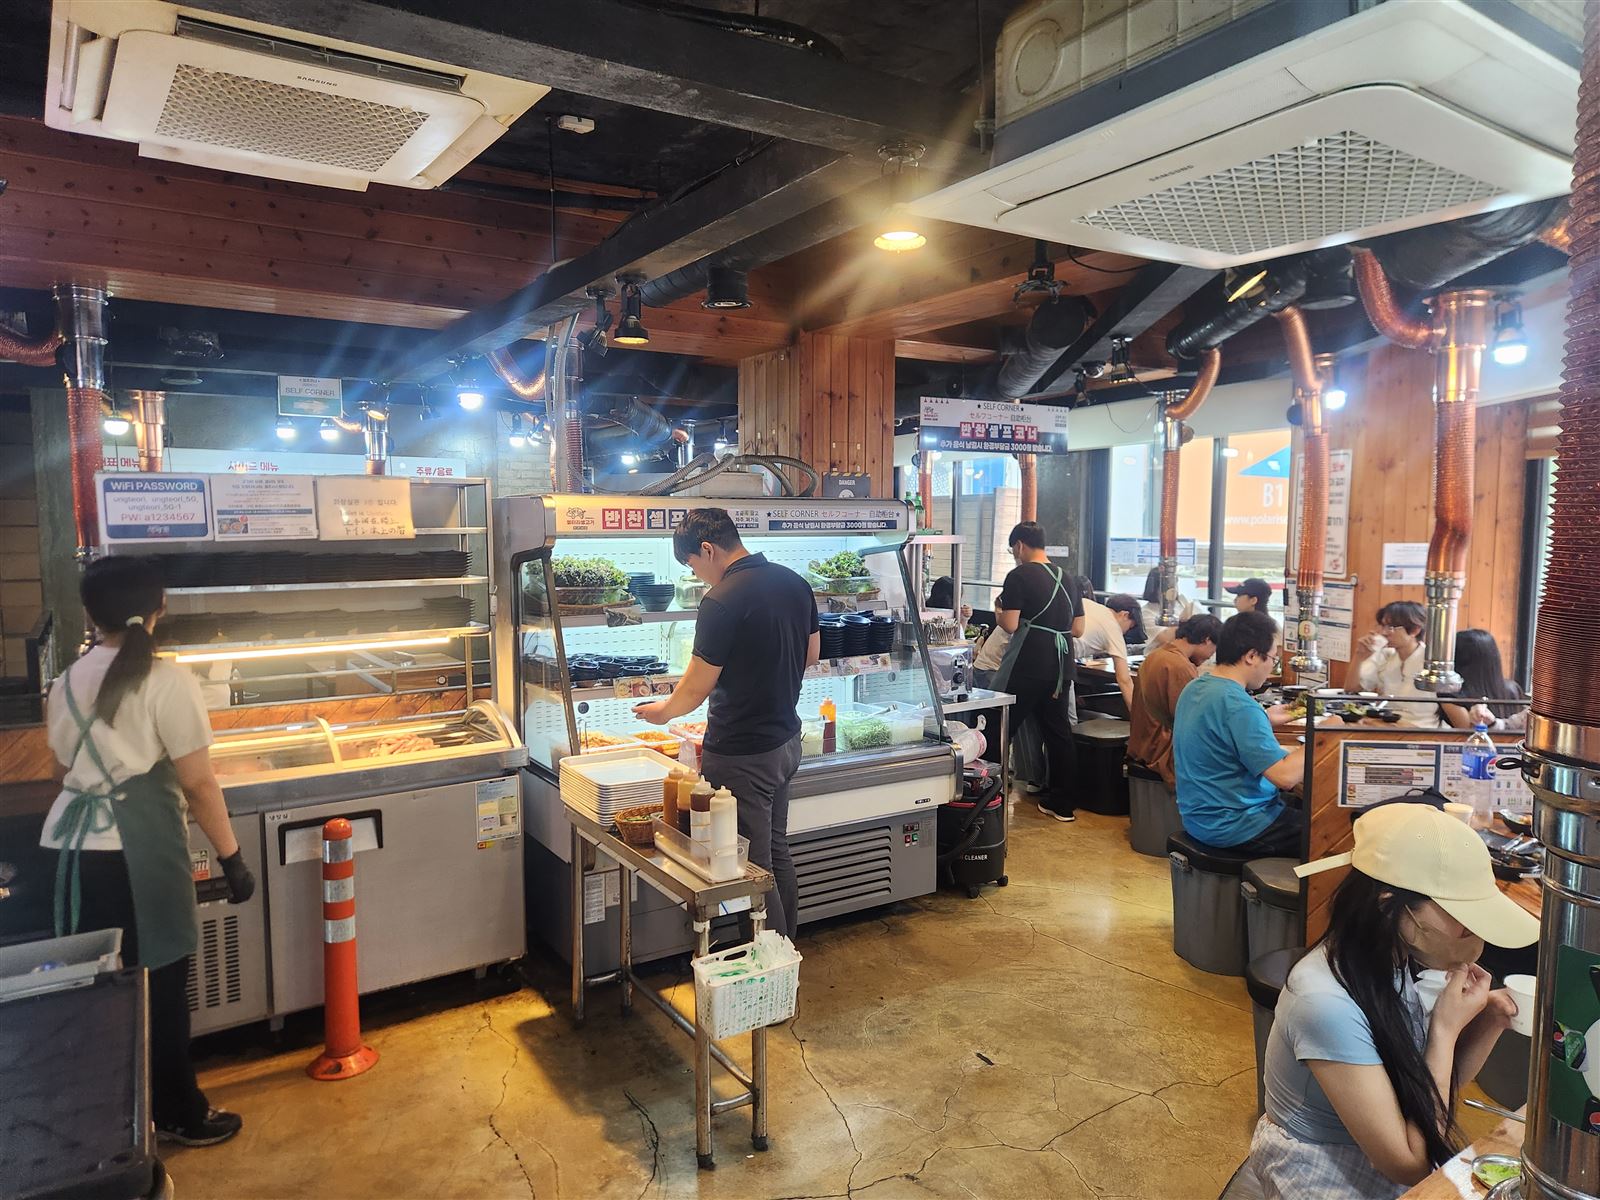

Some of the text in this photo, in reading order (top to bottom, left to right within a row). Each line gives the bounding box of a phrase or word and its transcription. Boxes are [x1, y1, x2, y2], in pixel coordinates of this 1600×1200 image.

[983, 402, 1020, 412] SELF CORNER
[416, 466, 453, 477] 주류/음료
[136, 481, 198, 491] PASSWORD
[1262, 482, 1285, 508] B1
[773, 509, 789, 518] SELF
[790, 509, 819, 518] CORNER
[604, 510, 643, 528] 반찬
